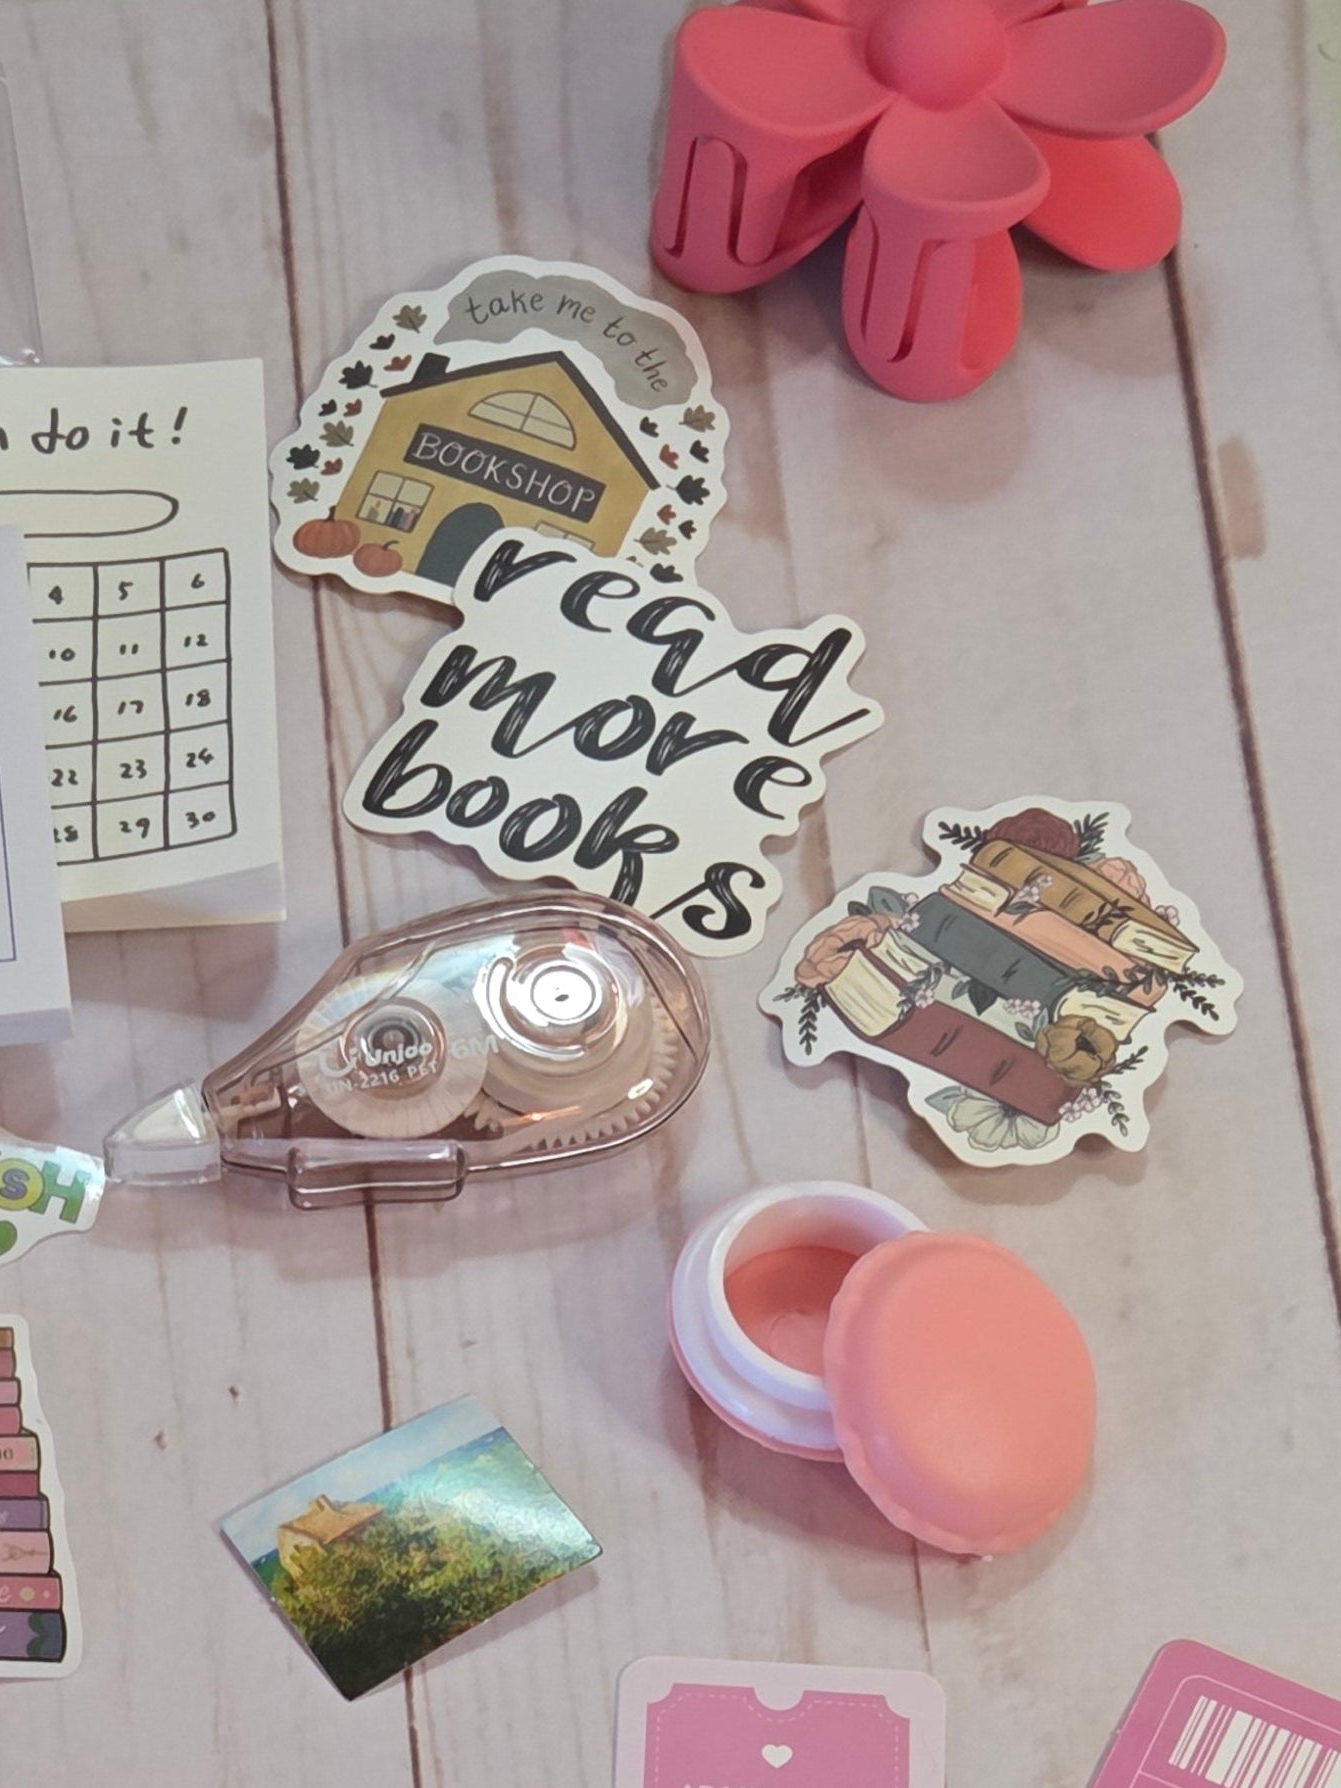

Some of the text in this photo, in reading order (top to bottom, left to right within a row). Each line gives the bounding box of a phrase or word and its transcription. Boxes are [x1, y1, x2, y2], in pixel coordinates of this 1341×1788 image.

[466, 289, 669, 393] take me to the
[31, 407, 90, 455] do
[411, 430, 599, 515] BOOKSHOP
[48, 573, 206, 606] 4 5 6
[48, 633, 209, 663] 10 11 12
[472, 538, 871, 747] read
[53, 689, 213, 724] 16 17 18
[420, 644, 814, 820] more
[50, 747, 215, 787] 22 23 24
[119, 818, 151, 839] 29
[185, 809, 217, 828] 30
[361, 718, 767, 940] books
[407, 1061, 438, 1079] PET
